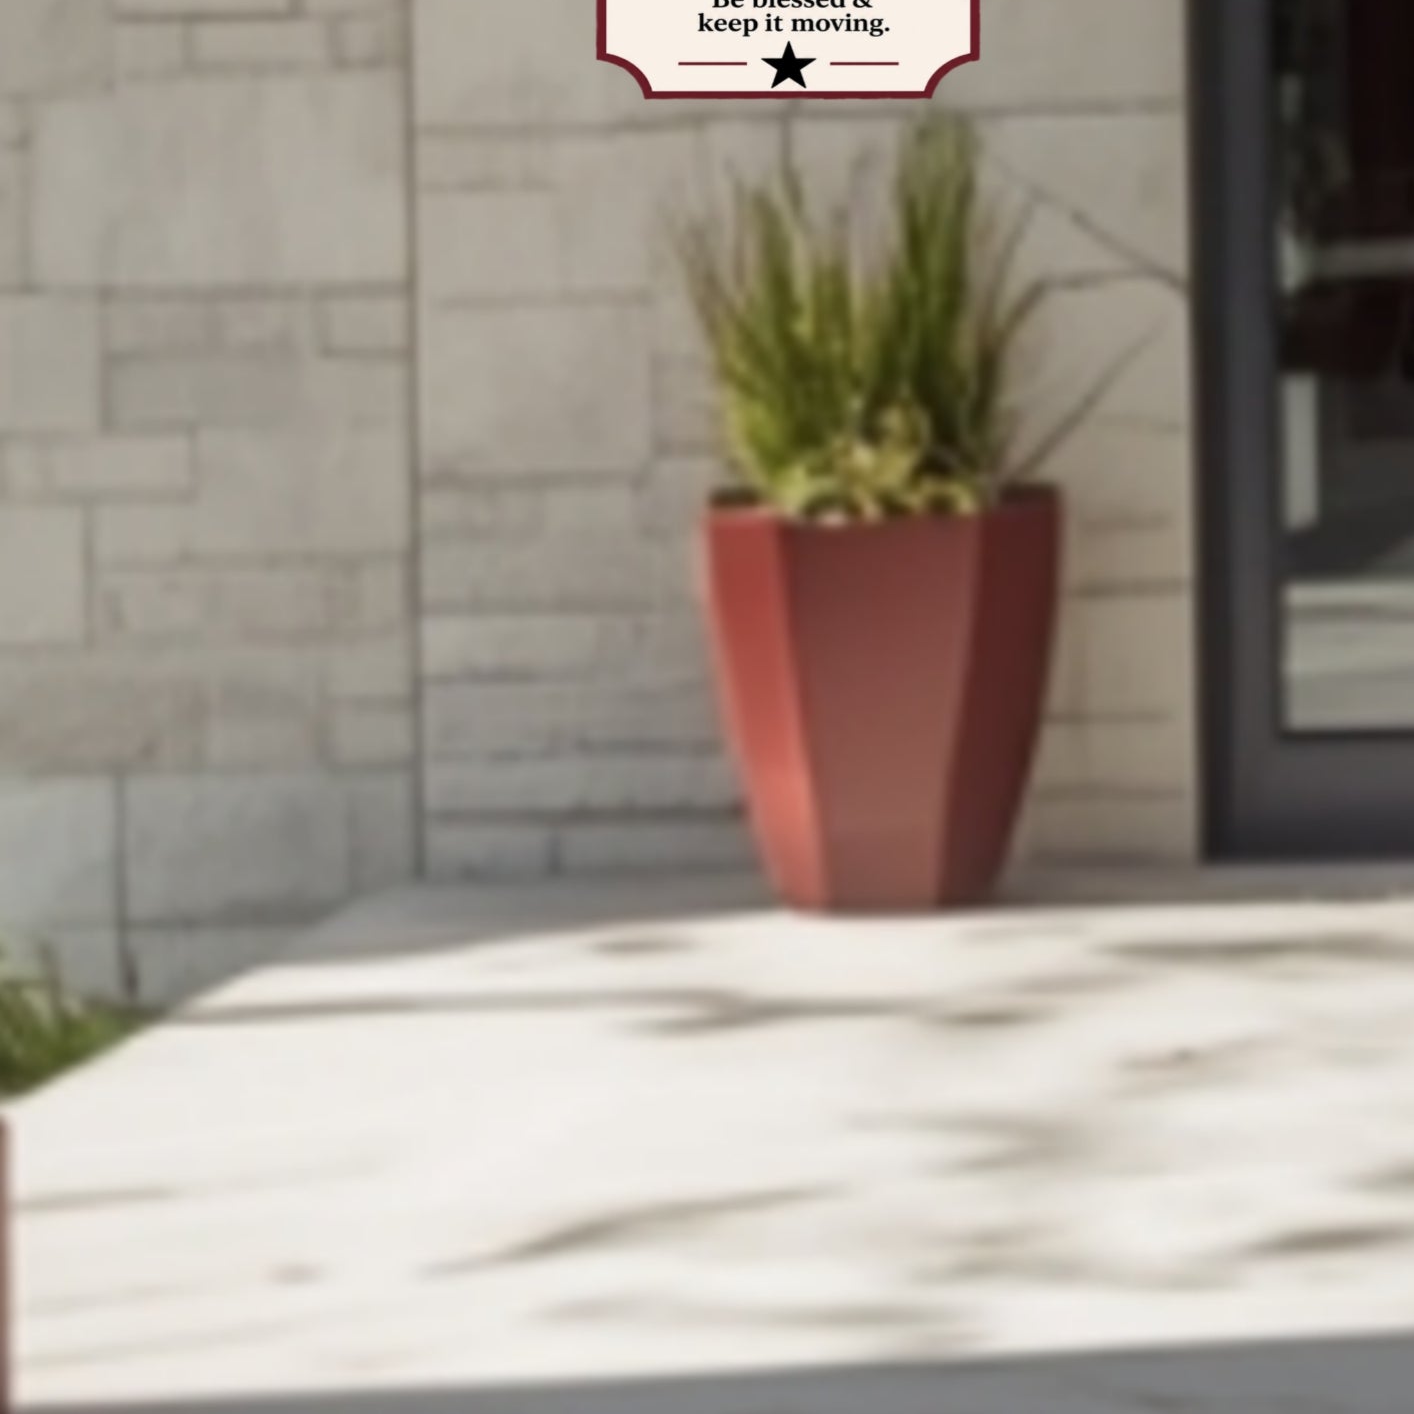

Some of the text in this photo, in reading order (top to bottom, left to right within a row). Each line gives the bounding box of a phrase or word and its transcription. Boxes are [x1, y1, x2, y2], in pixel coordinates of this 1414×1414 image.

[698, 13, 890, 37] keep it moving.
